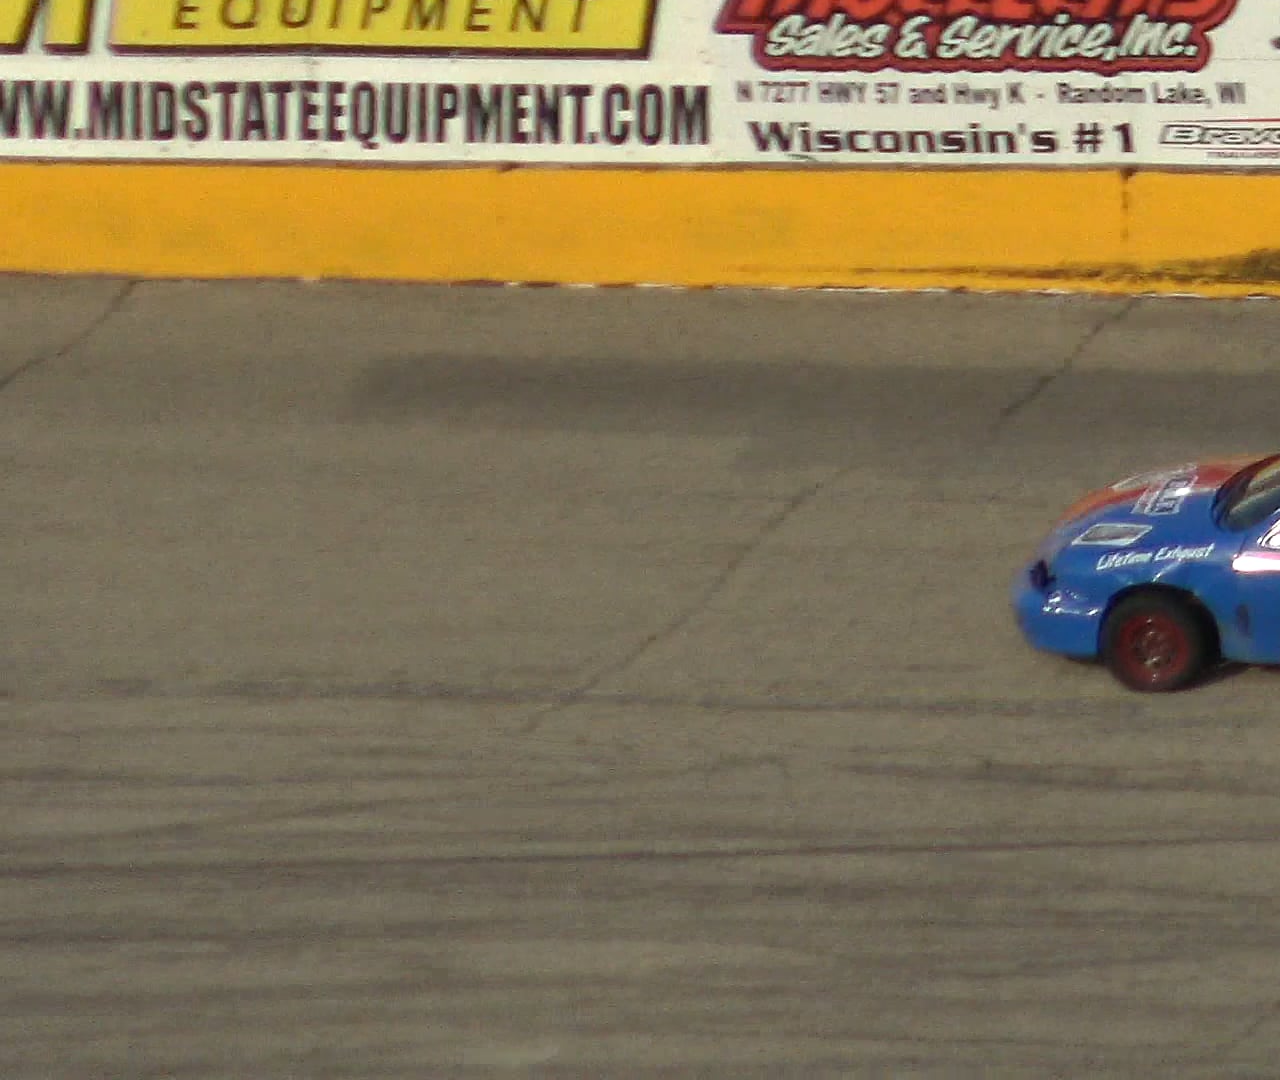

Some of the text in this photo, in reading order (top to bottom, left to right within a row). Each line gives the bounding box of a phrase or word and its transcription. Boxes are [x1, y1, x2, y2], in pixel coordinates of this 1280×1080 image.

[765, 14, 888, 58] Sales
[898, 16, 929, 59] &
[909, 82, 947, 104] and
[1056, 81, 1147, 104] Random
[747, 120, 1059, 154] Wisconsin's
[1073, 121, 1137, 154] #1
